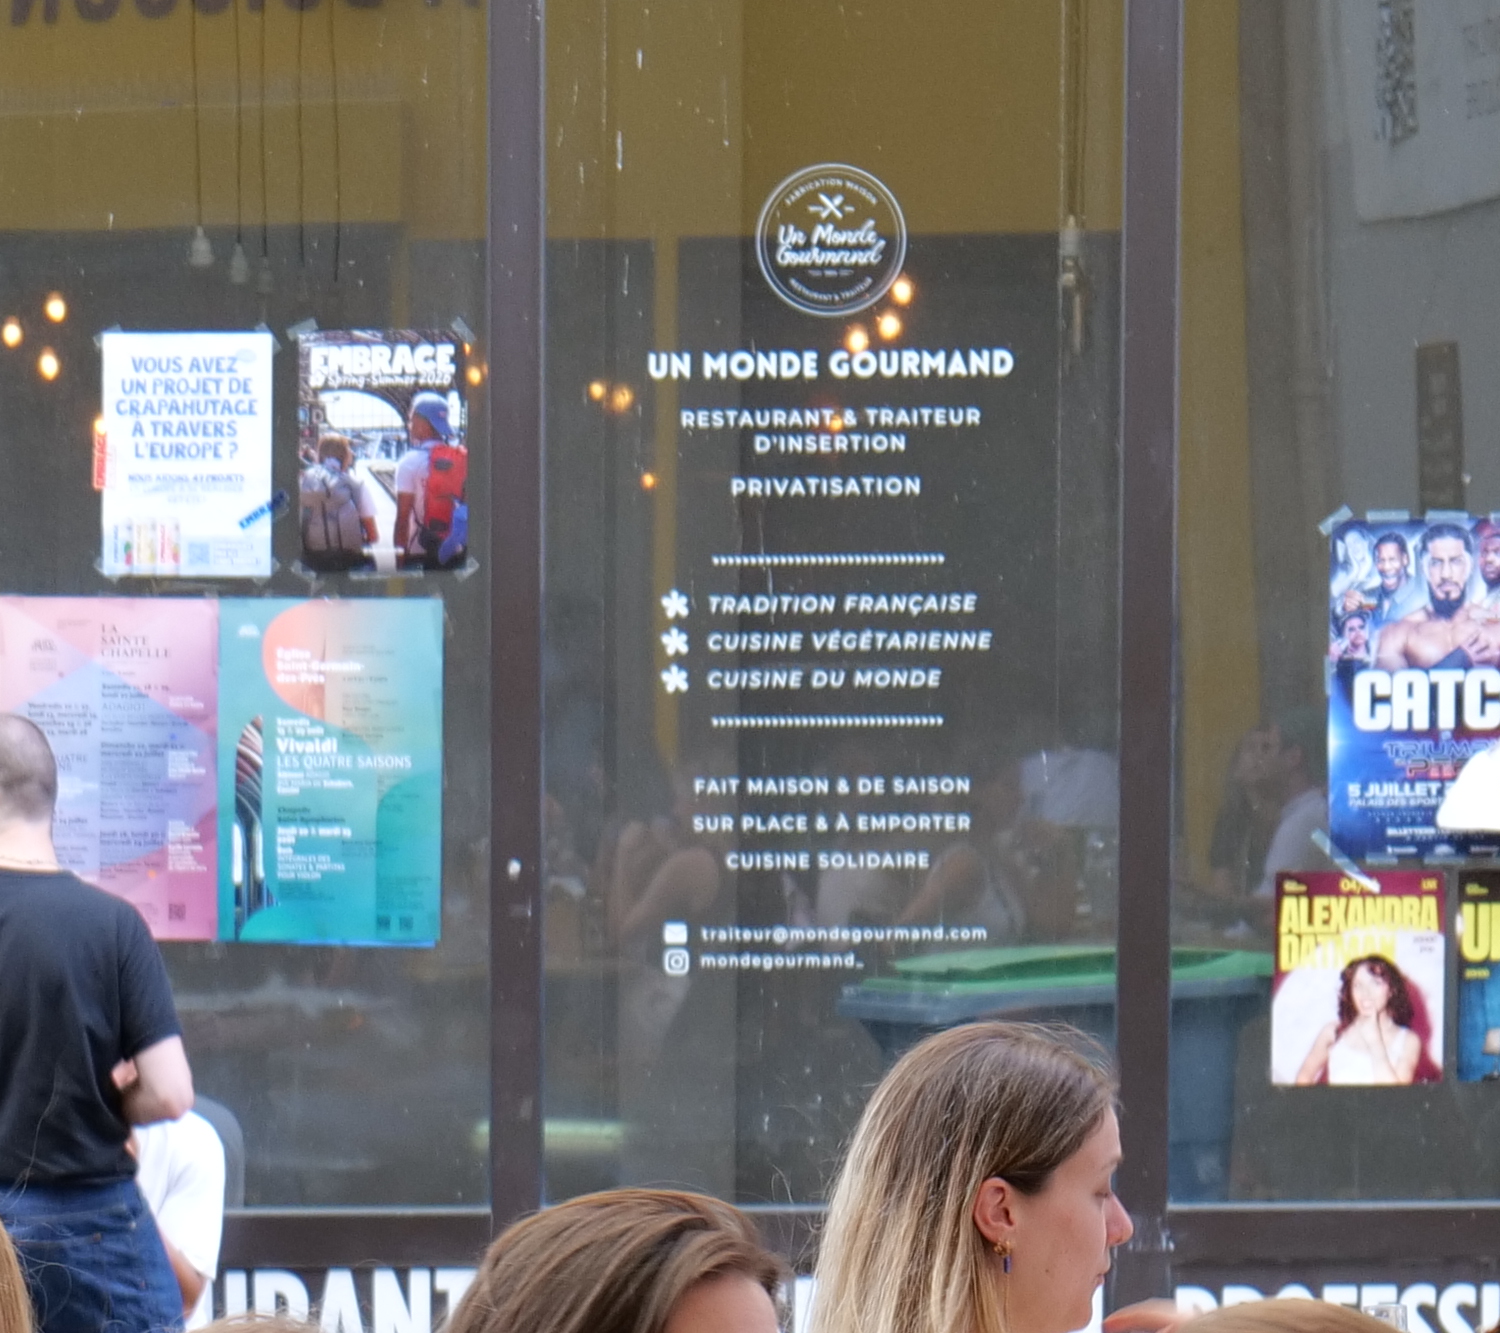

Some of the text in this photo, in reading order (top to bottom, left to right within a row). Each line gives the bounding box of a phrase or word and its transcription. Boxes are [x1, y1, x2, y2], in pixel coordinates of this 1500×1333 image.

[785, 178, 877, 206] FABRICATION MAISON
[777, 219, 877, 245] Un Monde
[776, 238, 886, 266] Gourmand
[131, 356, 239, 374] VOUS AVEZ
[310, 343, 456, 375] EMBRACE
[647, 348, 1014, 380] UN MONDE GOURMAND
[121, 378, 252, 395] UN PROJET DE
[328, 371, 414, 389] Spring-Summer
[115, 399, 258, 416] CRAPAHUTAGE
[131, 415, 238, 438] À TRAVERS
[681, 407, 981, 429] RESTAURANT & TRAITEUR
[134, 442, 239, 459] L'EUROPE ?
[754, 434, 906, 454] D'INSERTION
[730, 477, 921, 498] PRIVATISATION
[708, 594, 978, 618] TRADITION FRANÇAISE
[101, 635, 149, 646] SAINTE
[707, 628, 994, 652] CUISINE VÉGÉTARIENNE
[101, 647, 171, 659] CHAPELLE
[707, 671, 942, 690] CUISINE DU MONDE
[276, 737, 339, 754] Vivaldi
[276, 756, 412, 769] LES QUATRE SAISONS
[694, 778, 971, 796] FAIT MAISON & DE SAISON
[1347, 783, 1442, 798] 5 JUILLET
[1349, 798, 1384, 807] PALAIS
[1386, 798, 1409, 807] DES
[693, 810, 972, 833] SUR PLACE & À EMPORTER
[726, 853, 931, 871] CUISINE SOLIDAIRE
[1279, 895, 1439, 935] ALEXANDRA
[700, 924, 988, 945] traiteur@mondegourmand.com
[700, 953, 865, 971] mondegourmand_
